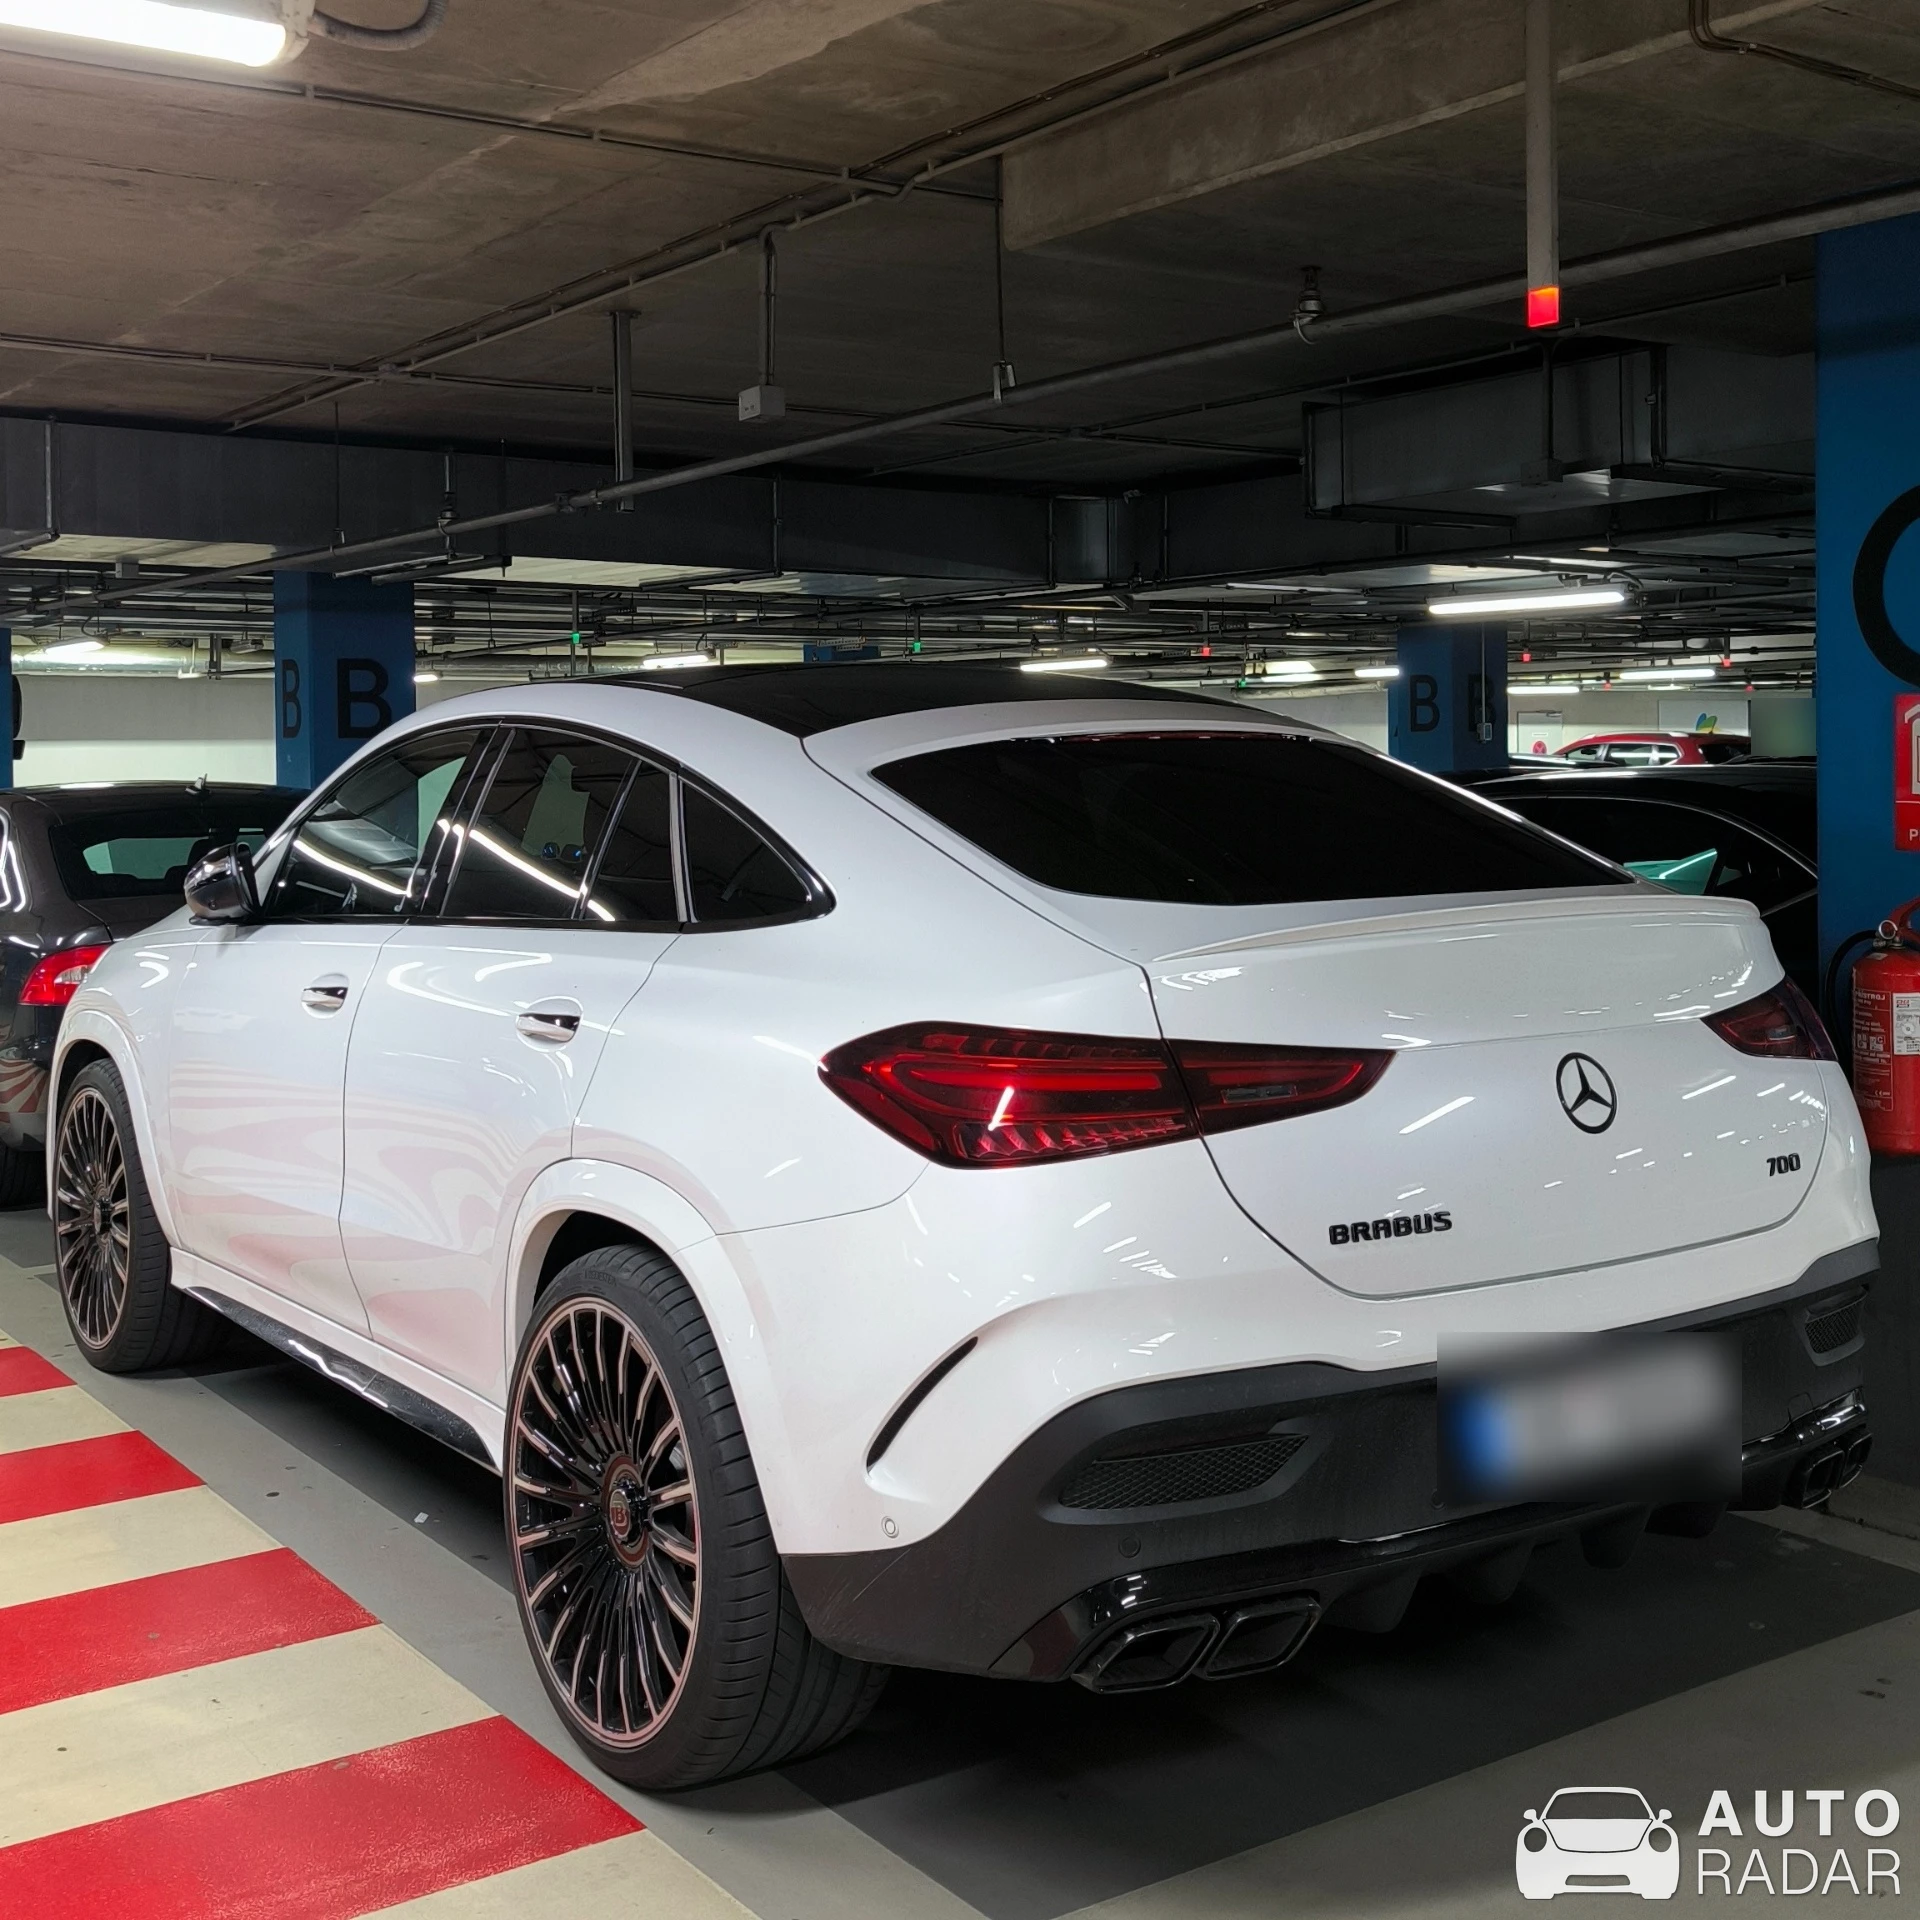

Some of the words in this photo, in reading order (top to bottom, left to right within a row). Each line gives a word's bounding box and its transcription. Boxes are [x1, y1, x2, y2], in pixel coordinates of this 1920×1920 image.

[282, 659, 302, 739] B
[337, 658, 393, 739] B
[1409, 675, 1440, 732] B
[1909, 828, 1920, 842] P
[1766, 1152, 1801, 1177] 700
[1329, 1211, 1452, 1245] BRABUS
